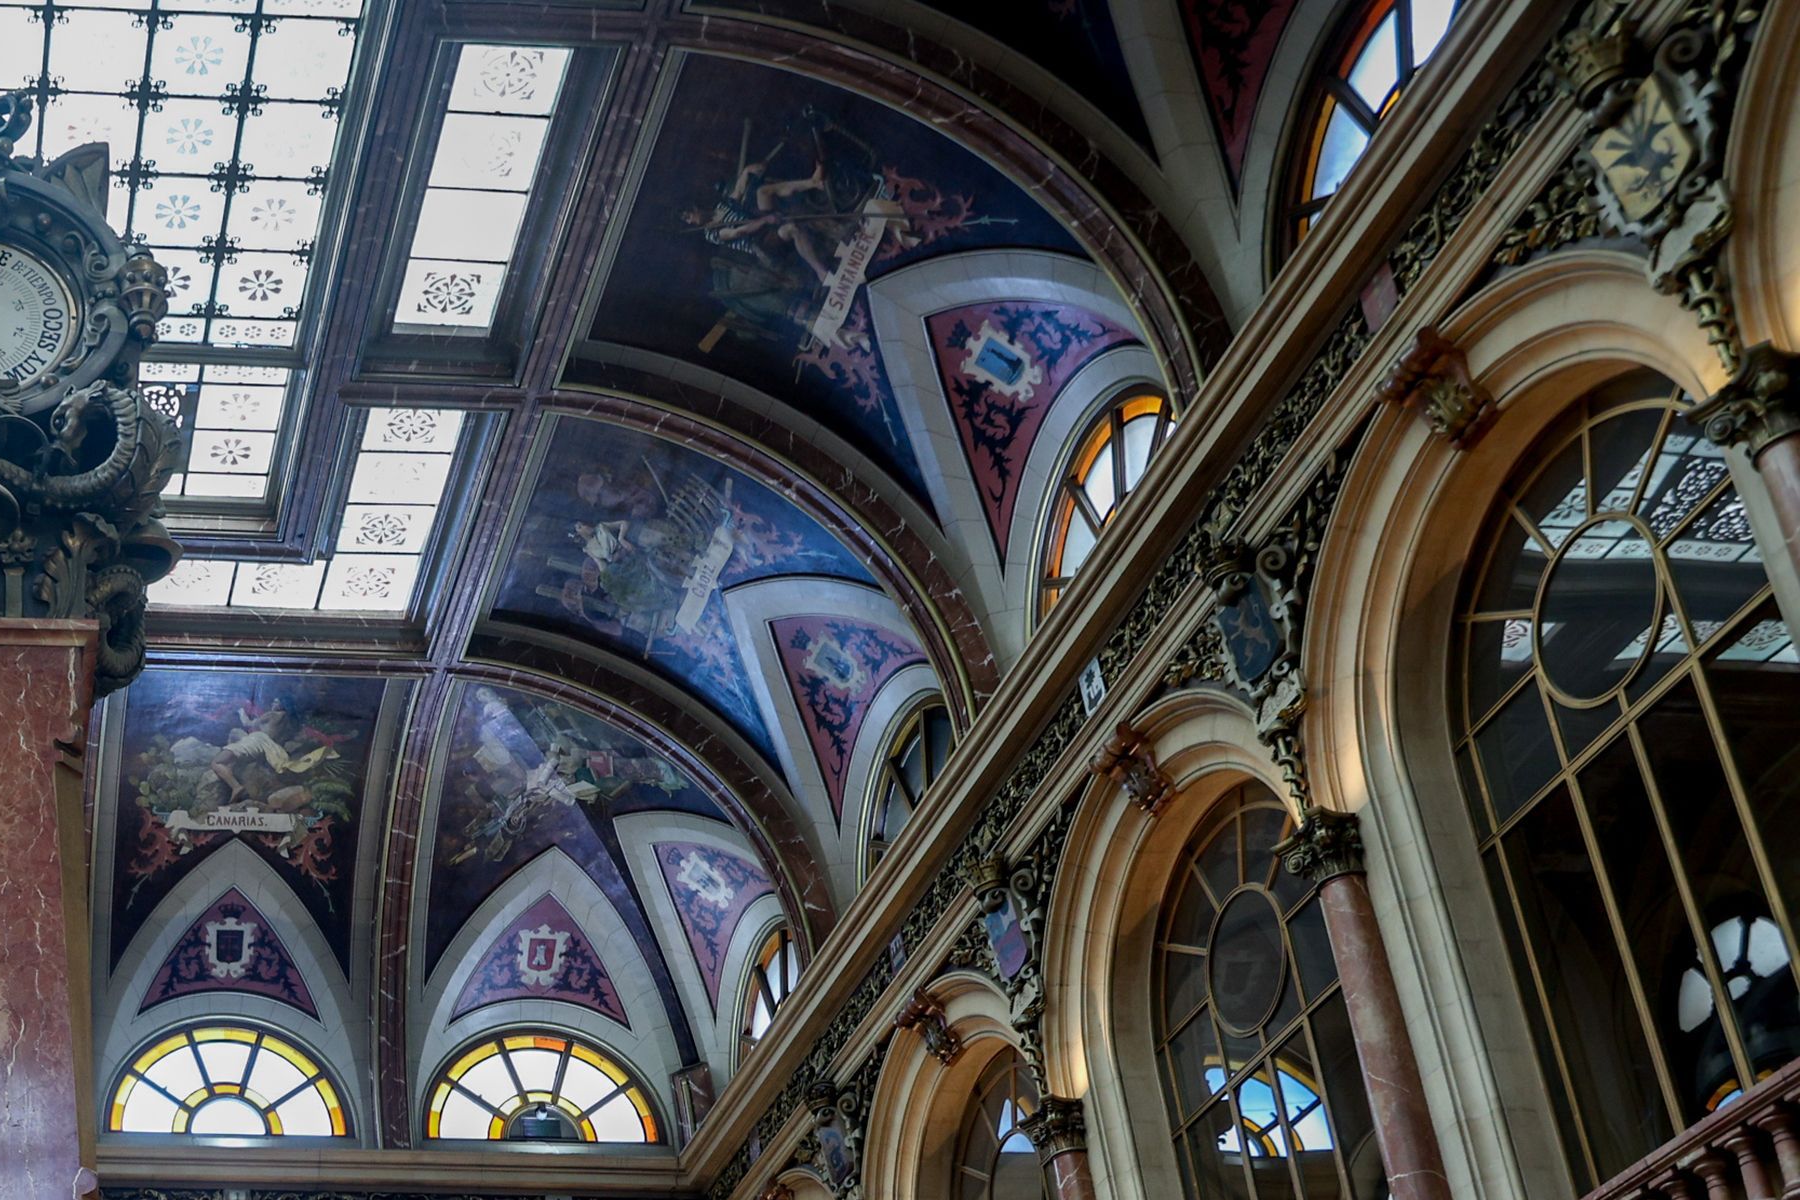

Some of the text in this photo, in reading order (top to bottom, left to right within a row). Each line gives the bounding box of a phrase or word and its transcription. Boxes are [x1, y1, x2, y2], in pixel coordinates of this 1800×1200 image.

[23, 267, 56, 305] TIEMPO
[3, 308, 63, 381] MUY SECO
[207, 815, 268, 826] CANARIAS.
